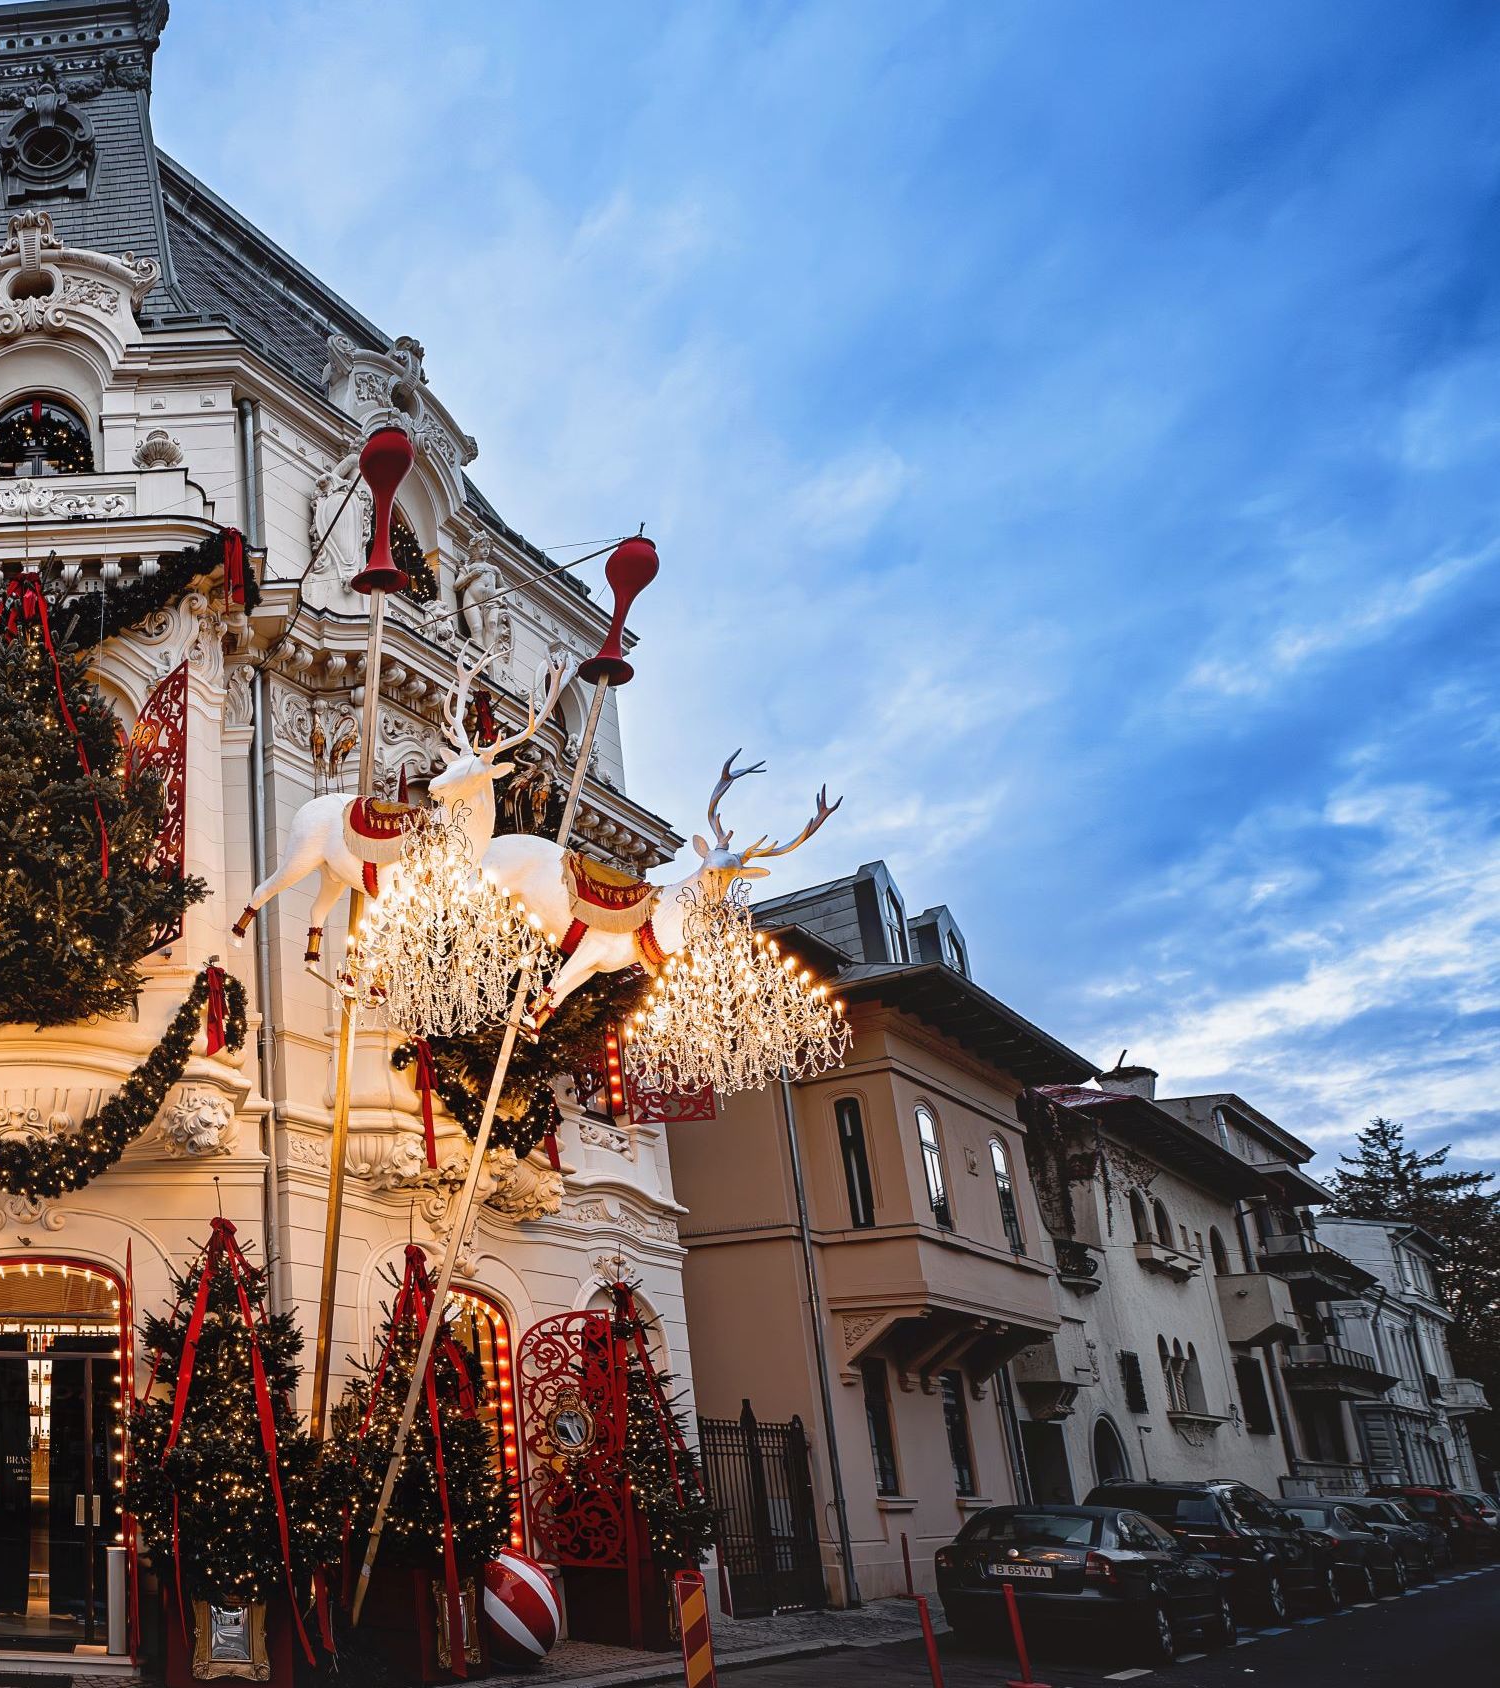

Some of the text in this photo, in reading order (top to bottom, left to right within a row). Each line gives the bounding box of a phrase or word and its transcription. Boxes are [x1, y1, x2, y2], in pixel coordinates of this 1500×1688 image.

[996, 1565, 1046, 1576] B 65 MYA
